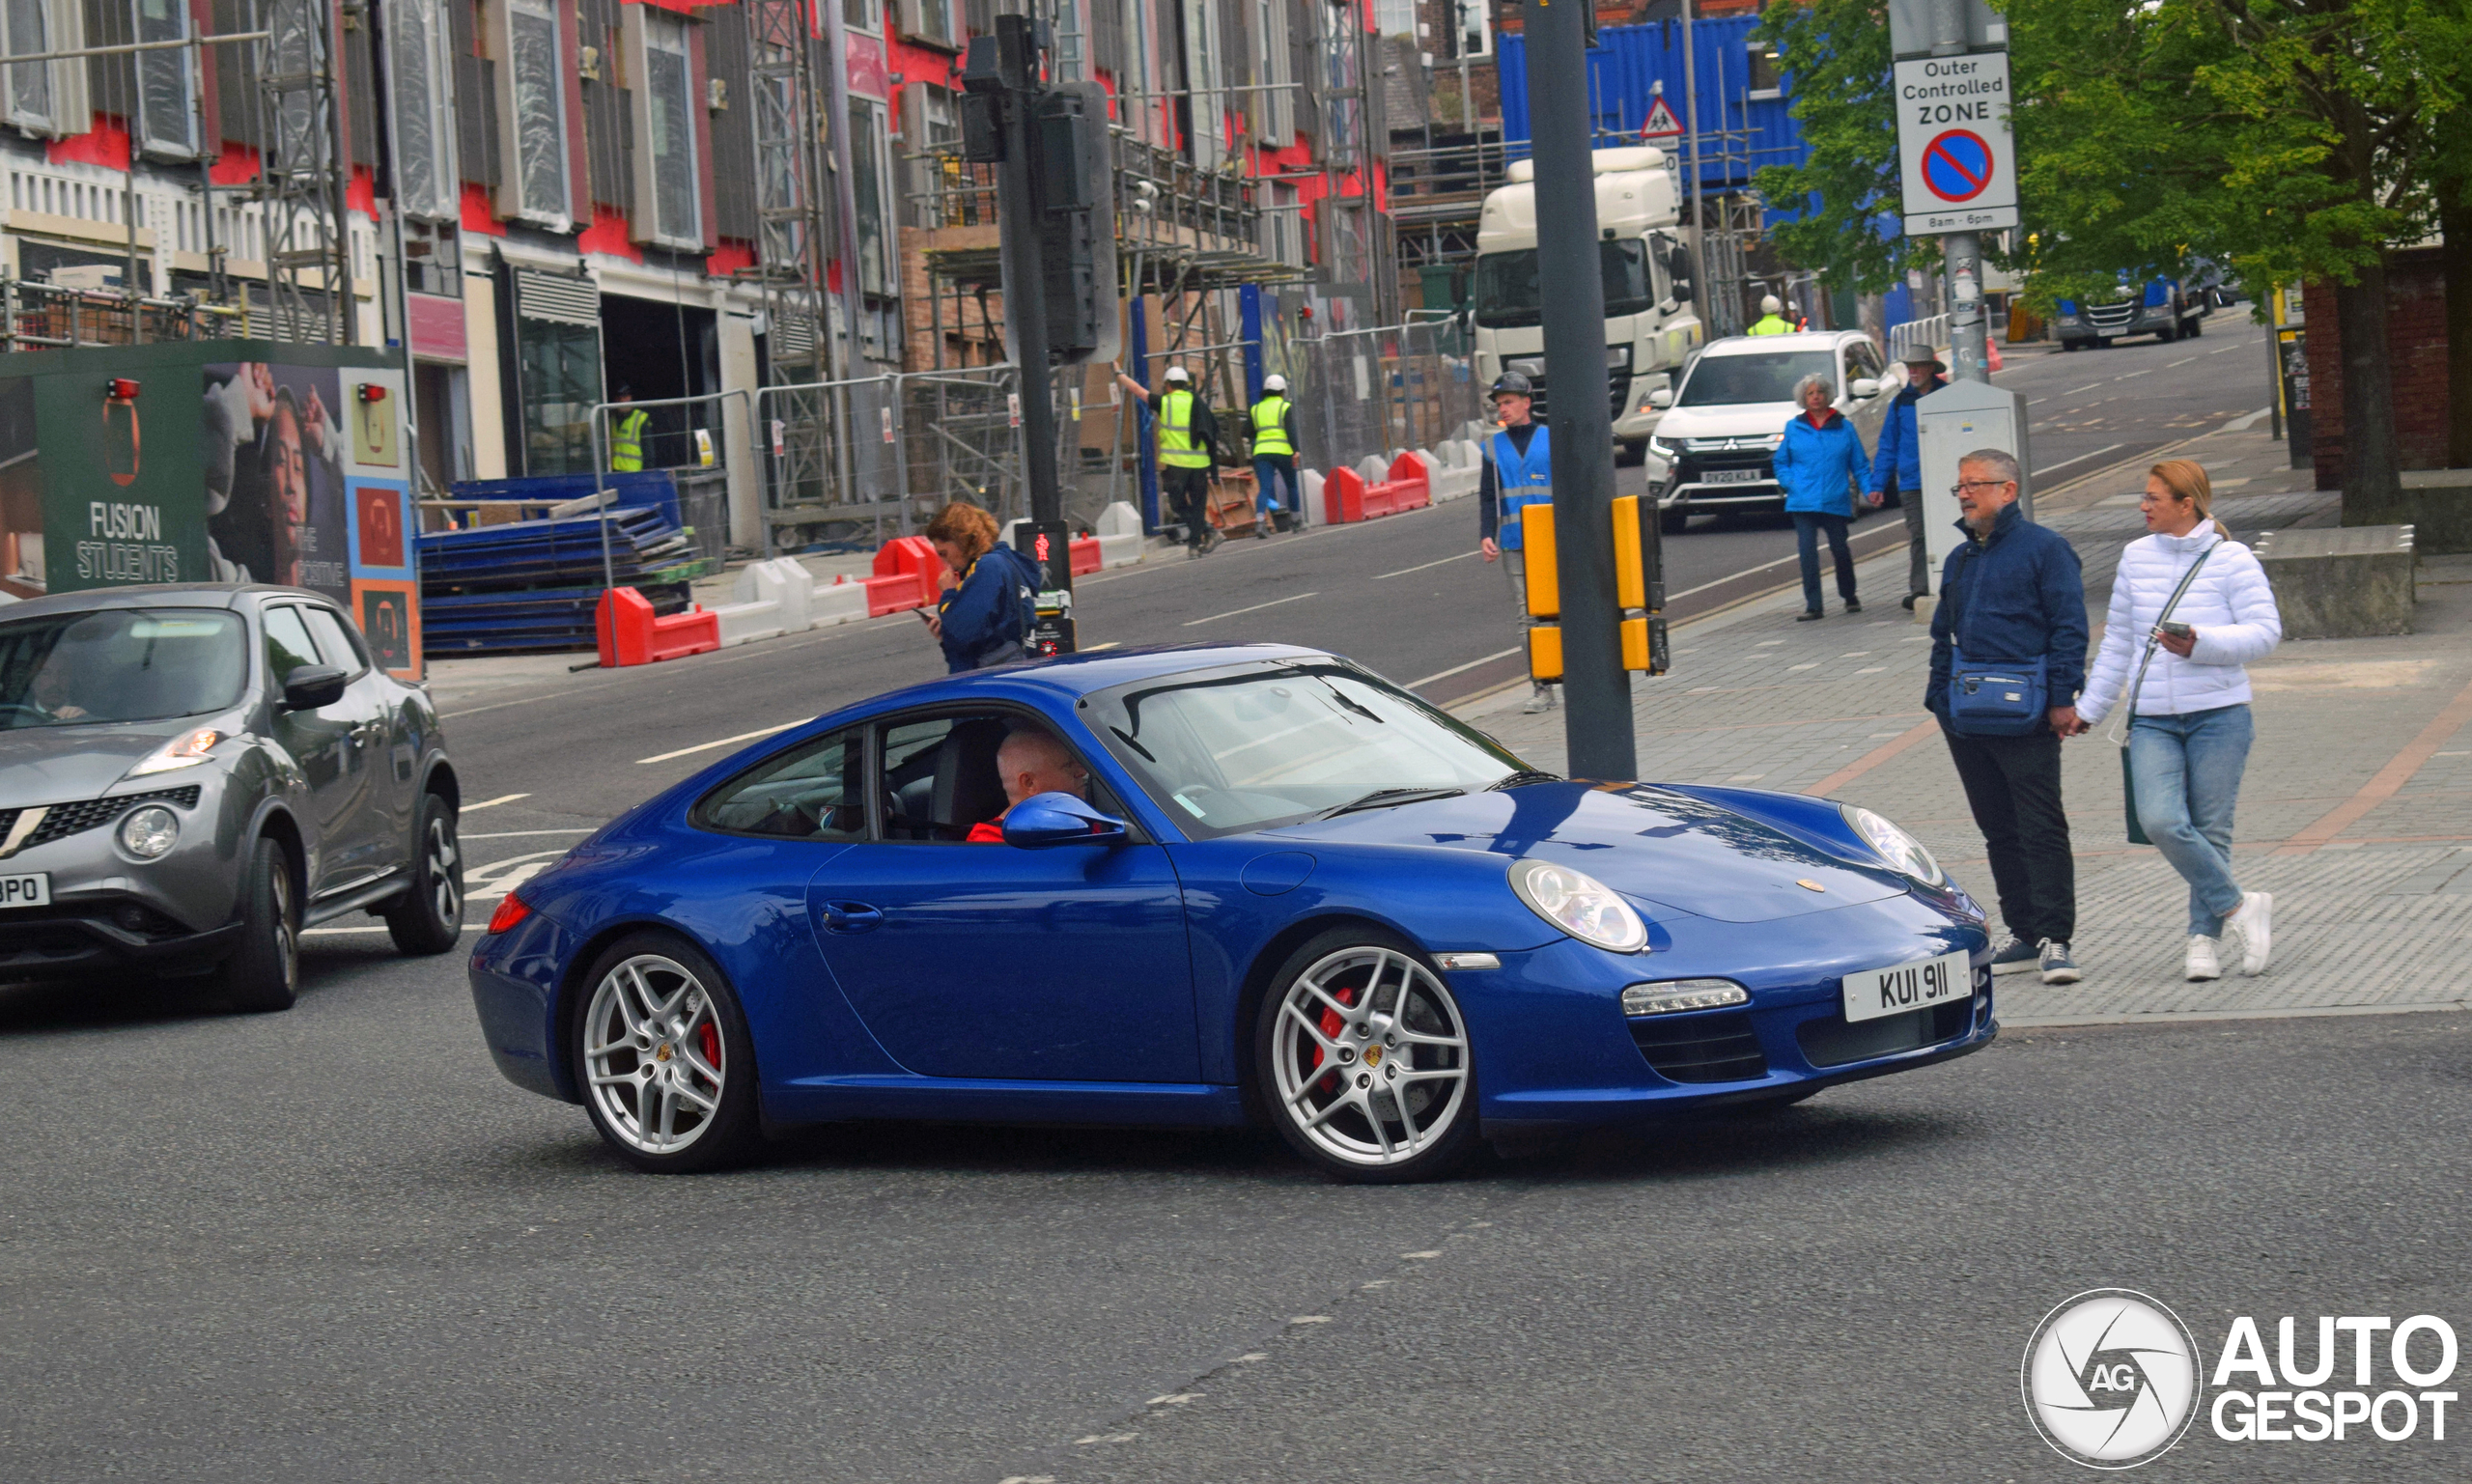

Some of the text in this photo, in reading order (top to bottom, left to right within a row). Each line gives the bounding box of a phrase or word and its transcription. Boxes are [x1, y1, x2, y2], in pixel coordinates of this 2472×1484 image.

[1924, 60, 1979, 77] Outer
[1903, 77, 2003, 100] Controlled
[1919, 101, 1989, 125] ZONE
[1928, 216, 1955, 228] 8am
[1967, 213, 1993, 225] 6pm
[90, 501, 160, 541] FUSION
[295, 525, 318, 552] THE
[76, 541, 179, 582] STUDENTS
[297, 560, 346, 587] POSITIVE
[0, 878, 38, 903] PO
[1879, 962, 1949, 1009] KUI 911
